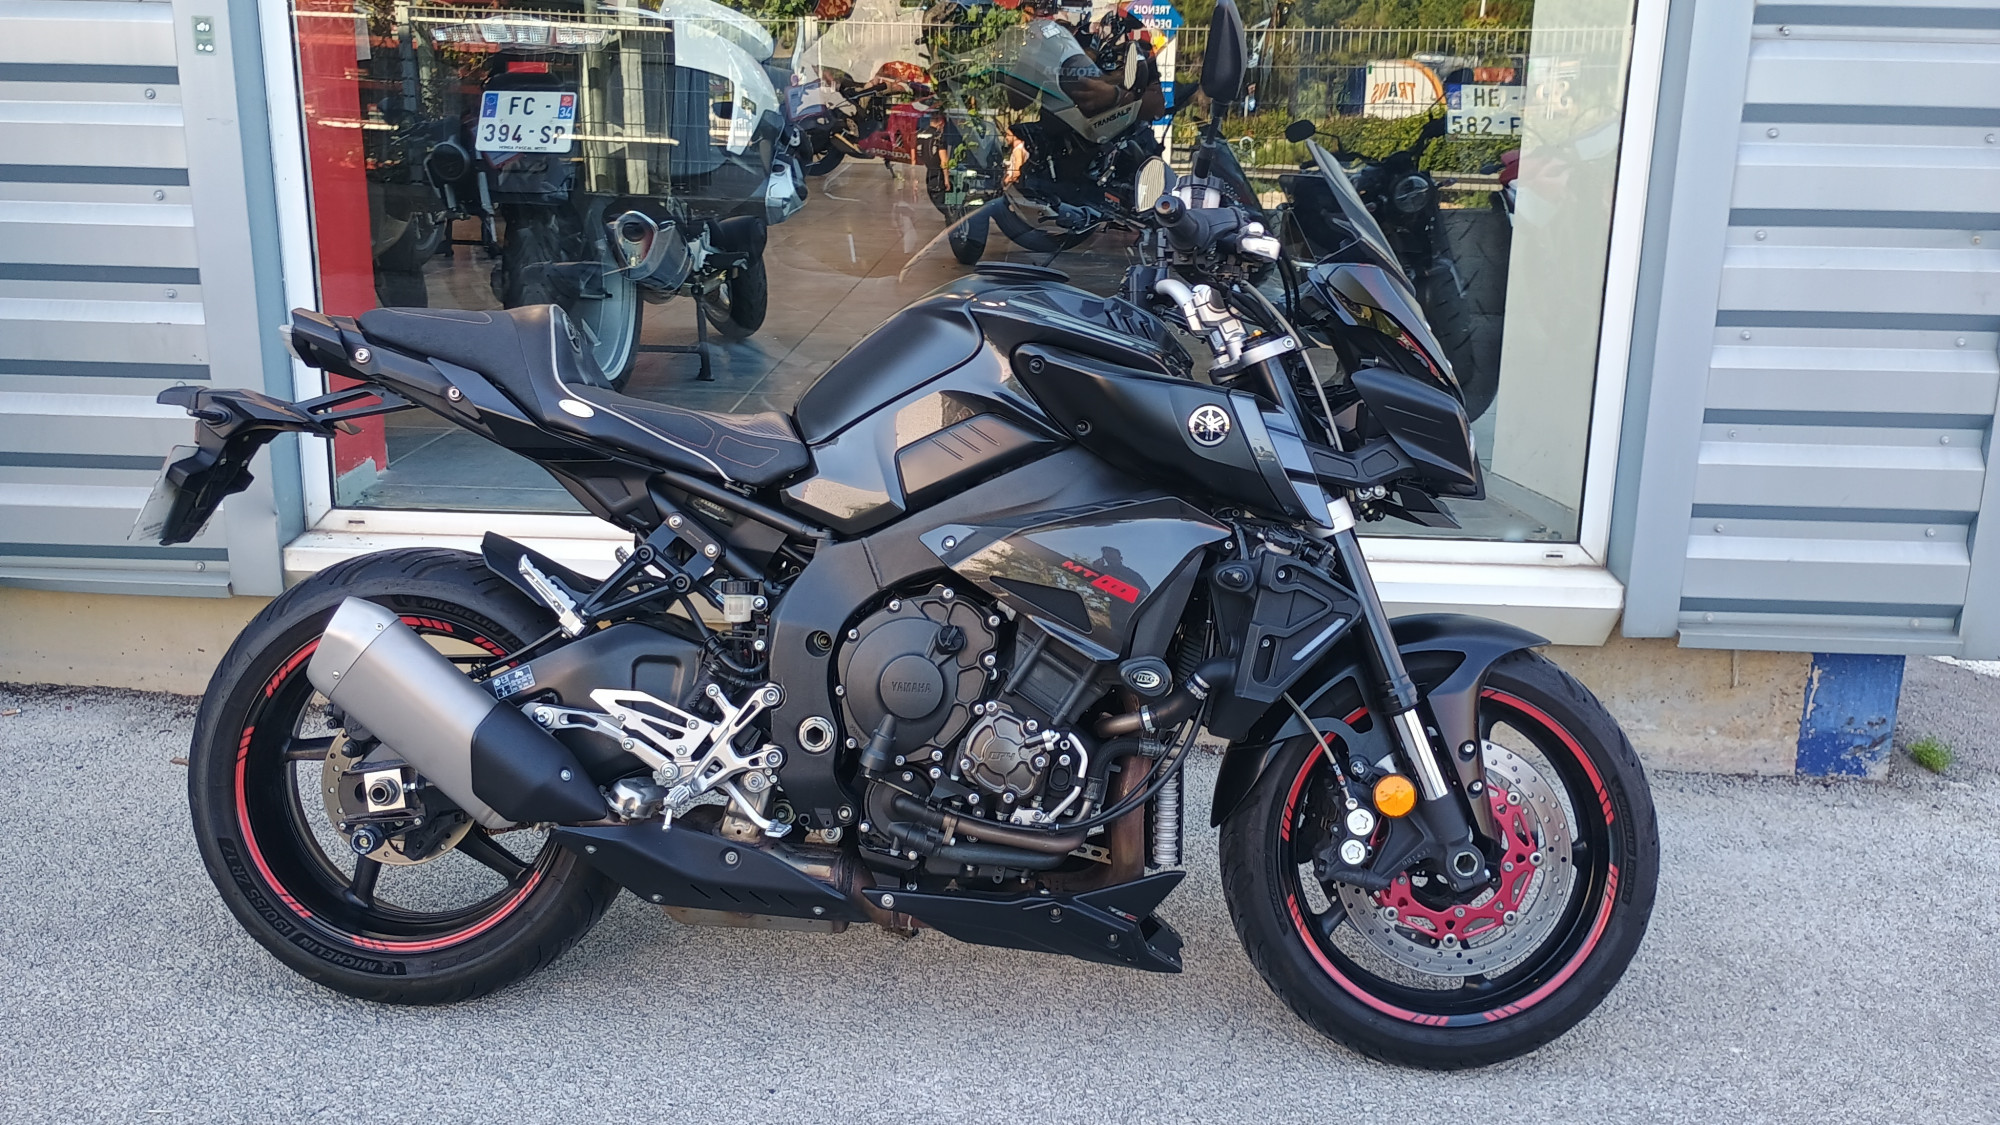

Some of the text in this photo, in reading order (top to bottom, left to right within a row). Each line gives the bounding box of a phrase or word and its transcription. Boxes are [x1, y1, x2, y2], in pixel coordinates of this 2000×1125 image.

[559, 106, 572, 118] 34
[1092, 107, 1132, 129] TRANSALP
[871, 147, 911, 159] HONDA
[421, 599, 500, 633] MICHELIN
[891, 680, 932, 694] YAMAHA
[222, 845, 378, 973] MICHELIN 190/55 ZR 17
